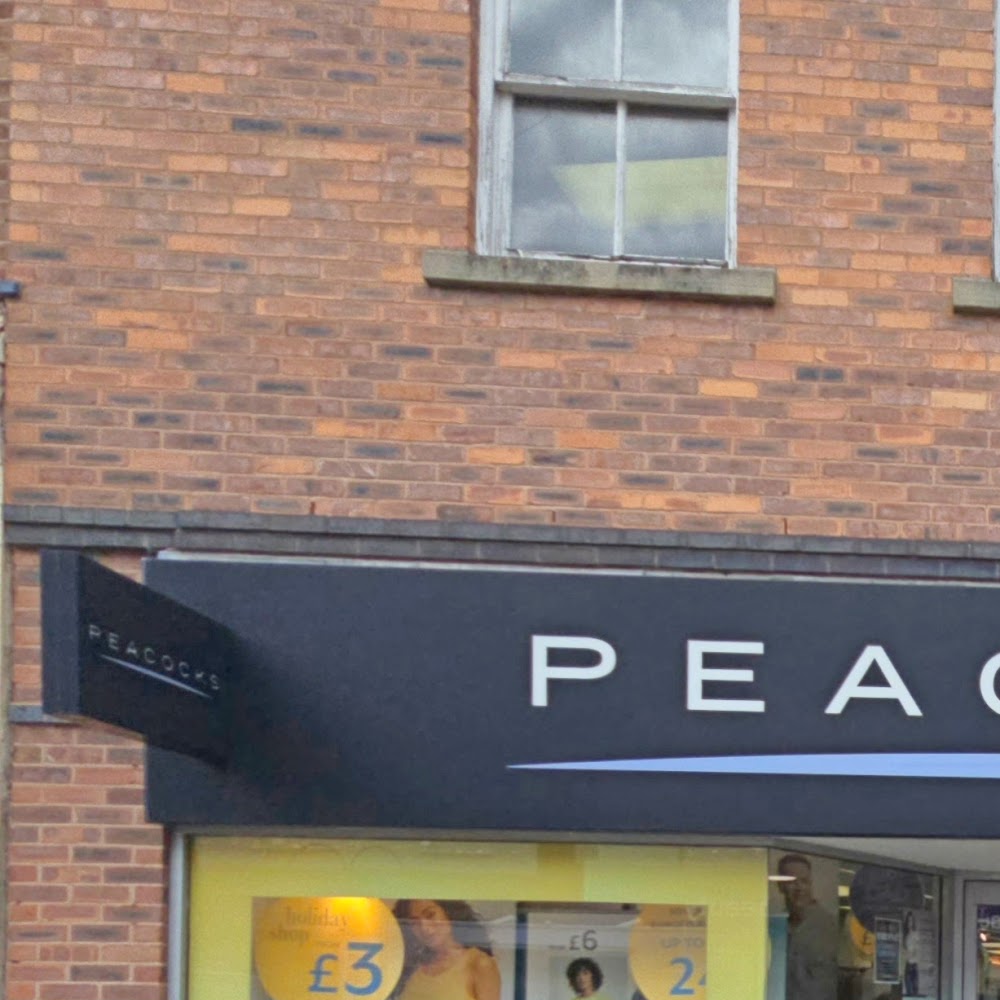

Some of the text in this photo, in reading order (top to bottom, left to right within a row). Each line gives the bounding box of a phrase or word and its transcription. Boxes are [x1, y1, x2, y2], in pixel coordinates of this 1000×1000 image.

[88, 624, 221, 690] PEACOCKS
[569, 929, 599, 952] £6
[308, 941, 385, 996] £3
